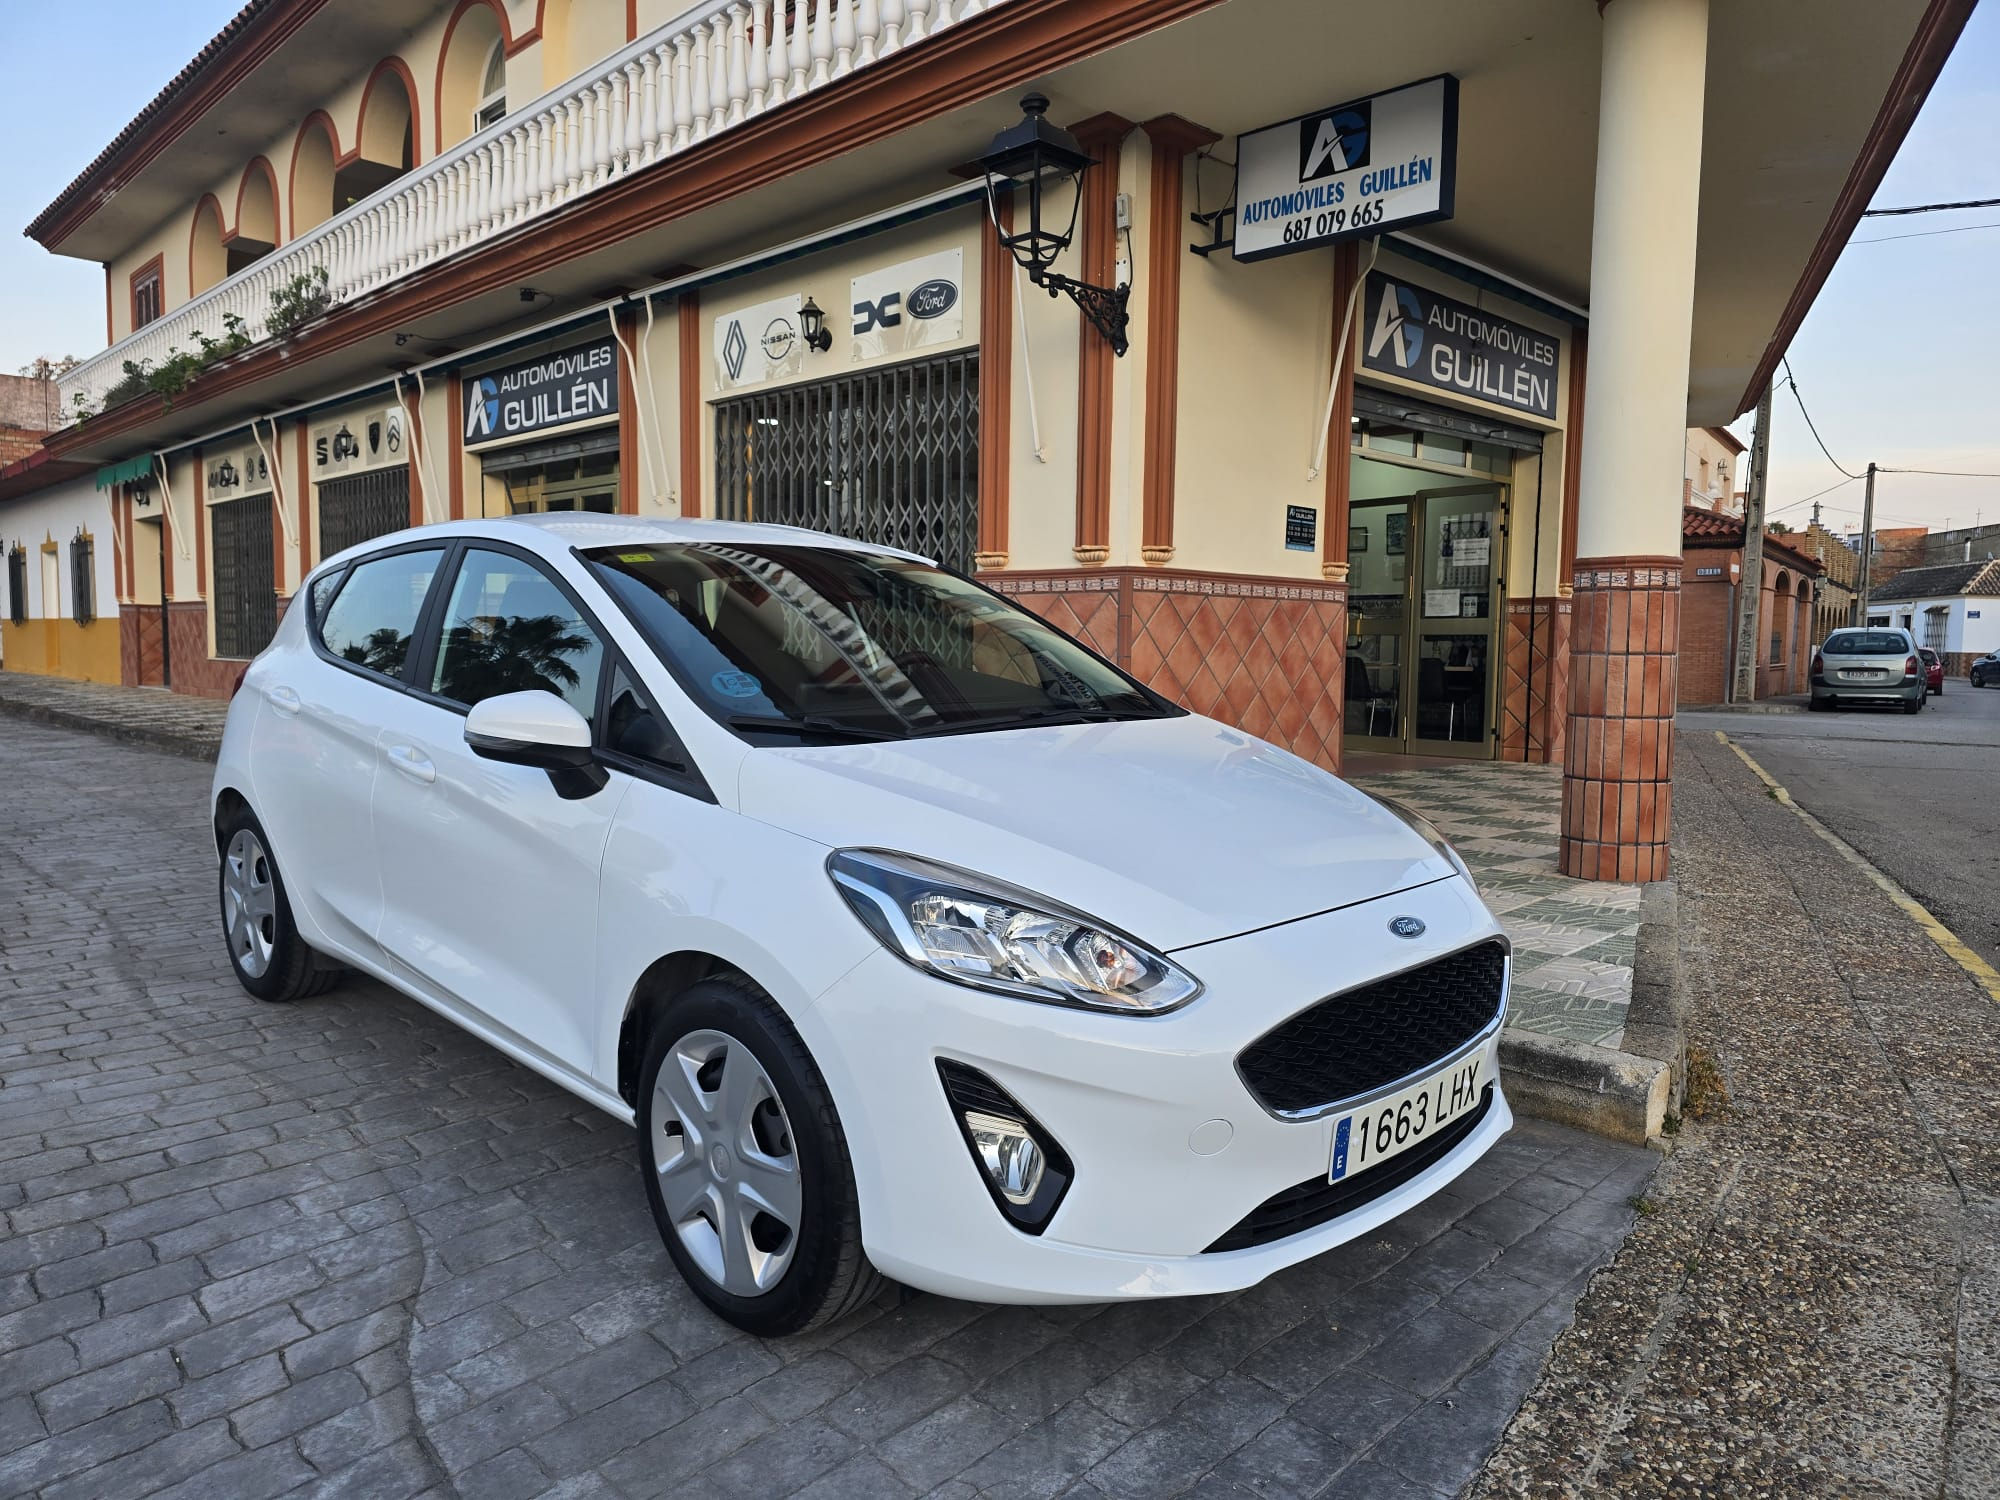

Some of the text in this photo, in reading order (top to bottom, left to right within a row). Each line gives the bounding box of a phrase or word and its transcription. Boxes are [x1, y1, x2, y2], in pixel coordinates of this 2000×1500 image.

[1243, 155, 1432, 225] AUTOMÓVILES GUILLÉN
[1283, 199, 1384, 243] 687 079 665
[917, 286, 946, 312] Ford
[761, 331, 796, 346] NISSAN
[1428, 304, 1554, 367] AUTOMÓVILES
[500, 346, 611, 393] AUTOMÓVILES
[1431, 344, 1549, 411] GUILLÉN
[504, 377, 608, 431] GUILLÉN
[1360, 1060, 1480, 1162] 1663 LHX
[1337, 1155, 1343, 1169] E
